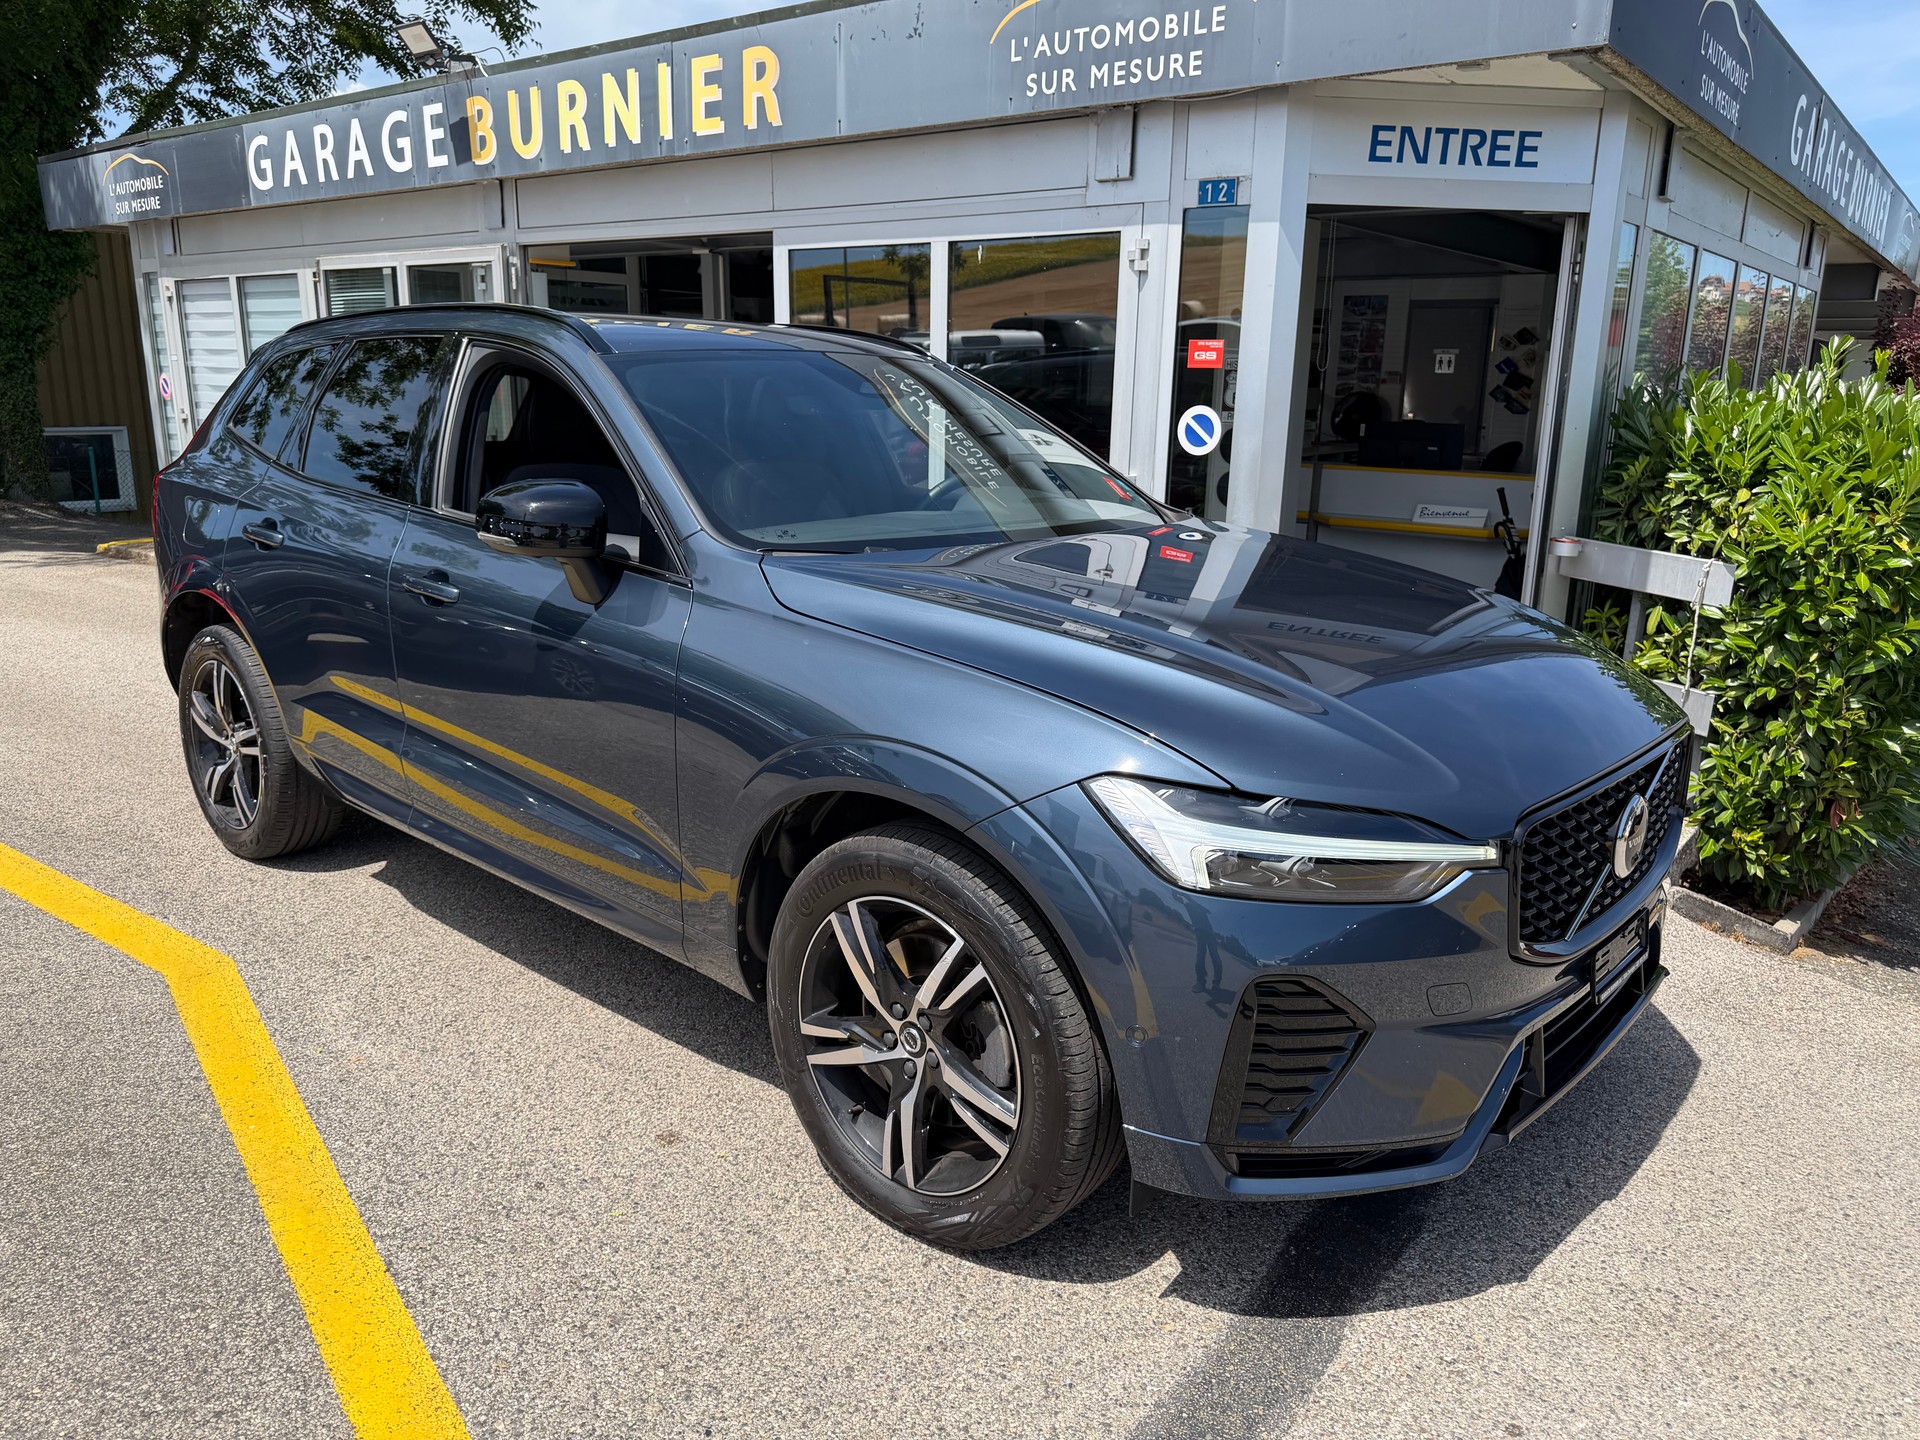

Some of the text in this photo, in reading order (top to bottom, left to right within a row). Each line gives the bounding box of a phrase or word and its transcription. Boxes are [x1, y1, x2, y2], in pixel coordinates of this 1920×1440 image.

[1010, 5, 1227, 63] L'AUTOMOBILE
[1026, 50, 1204, 97] SUR MESURE
[1700, 29, 1749, 95] L'AUTOMOBILE
[247, 45, 783, 192] GARAGE BURNIER
[1700, 73, 1740, 126] SUR MESURE
[1367, 124, 1543, 168] ENTREE
[1790, 94, 1892, 245] GARAGE BURNIER
[109, 175, 164, 197] L'AUTOMOBILE
[115, 196, 161, 215] SUR MESURE
[1205, 182, 1228, 203] 12
[1194, 351, 1217, 360] GS
[1419, 506, 1470, 518] Bienvenue
[795, 859, 881, 919] Continental
